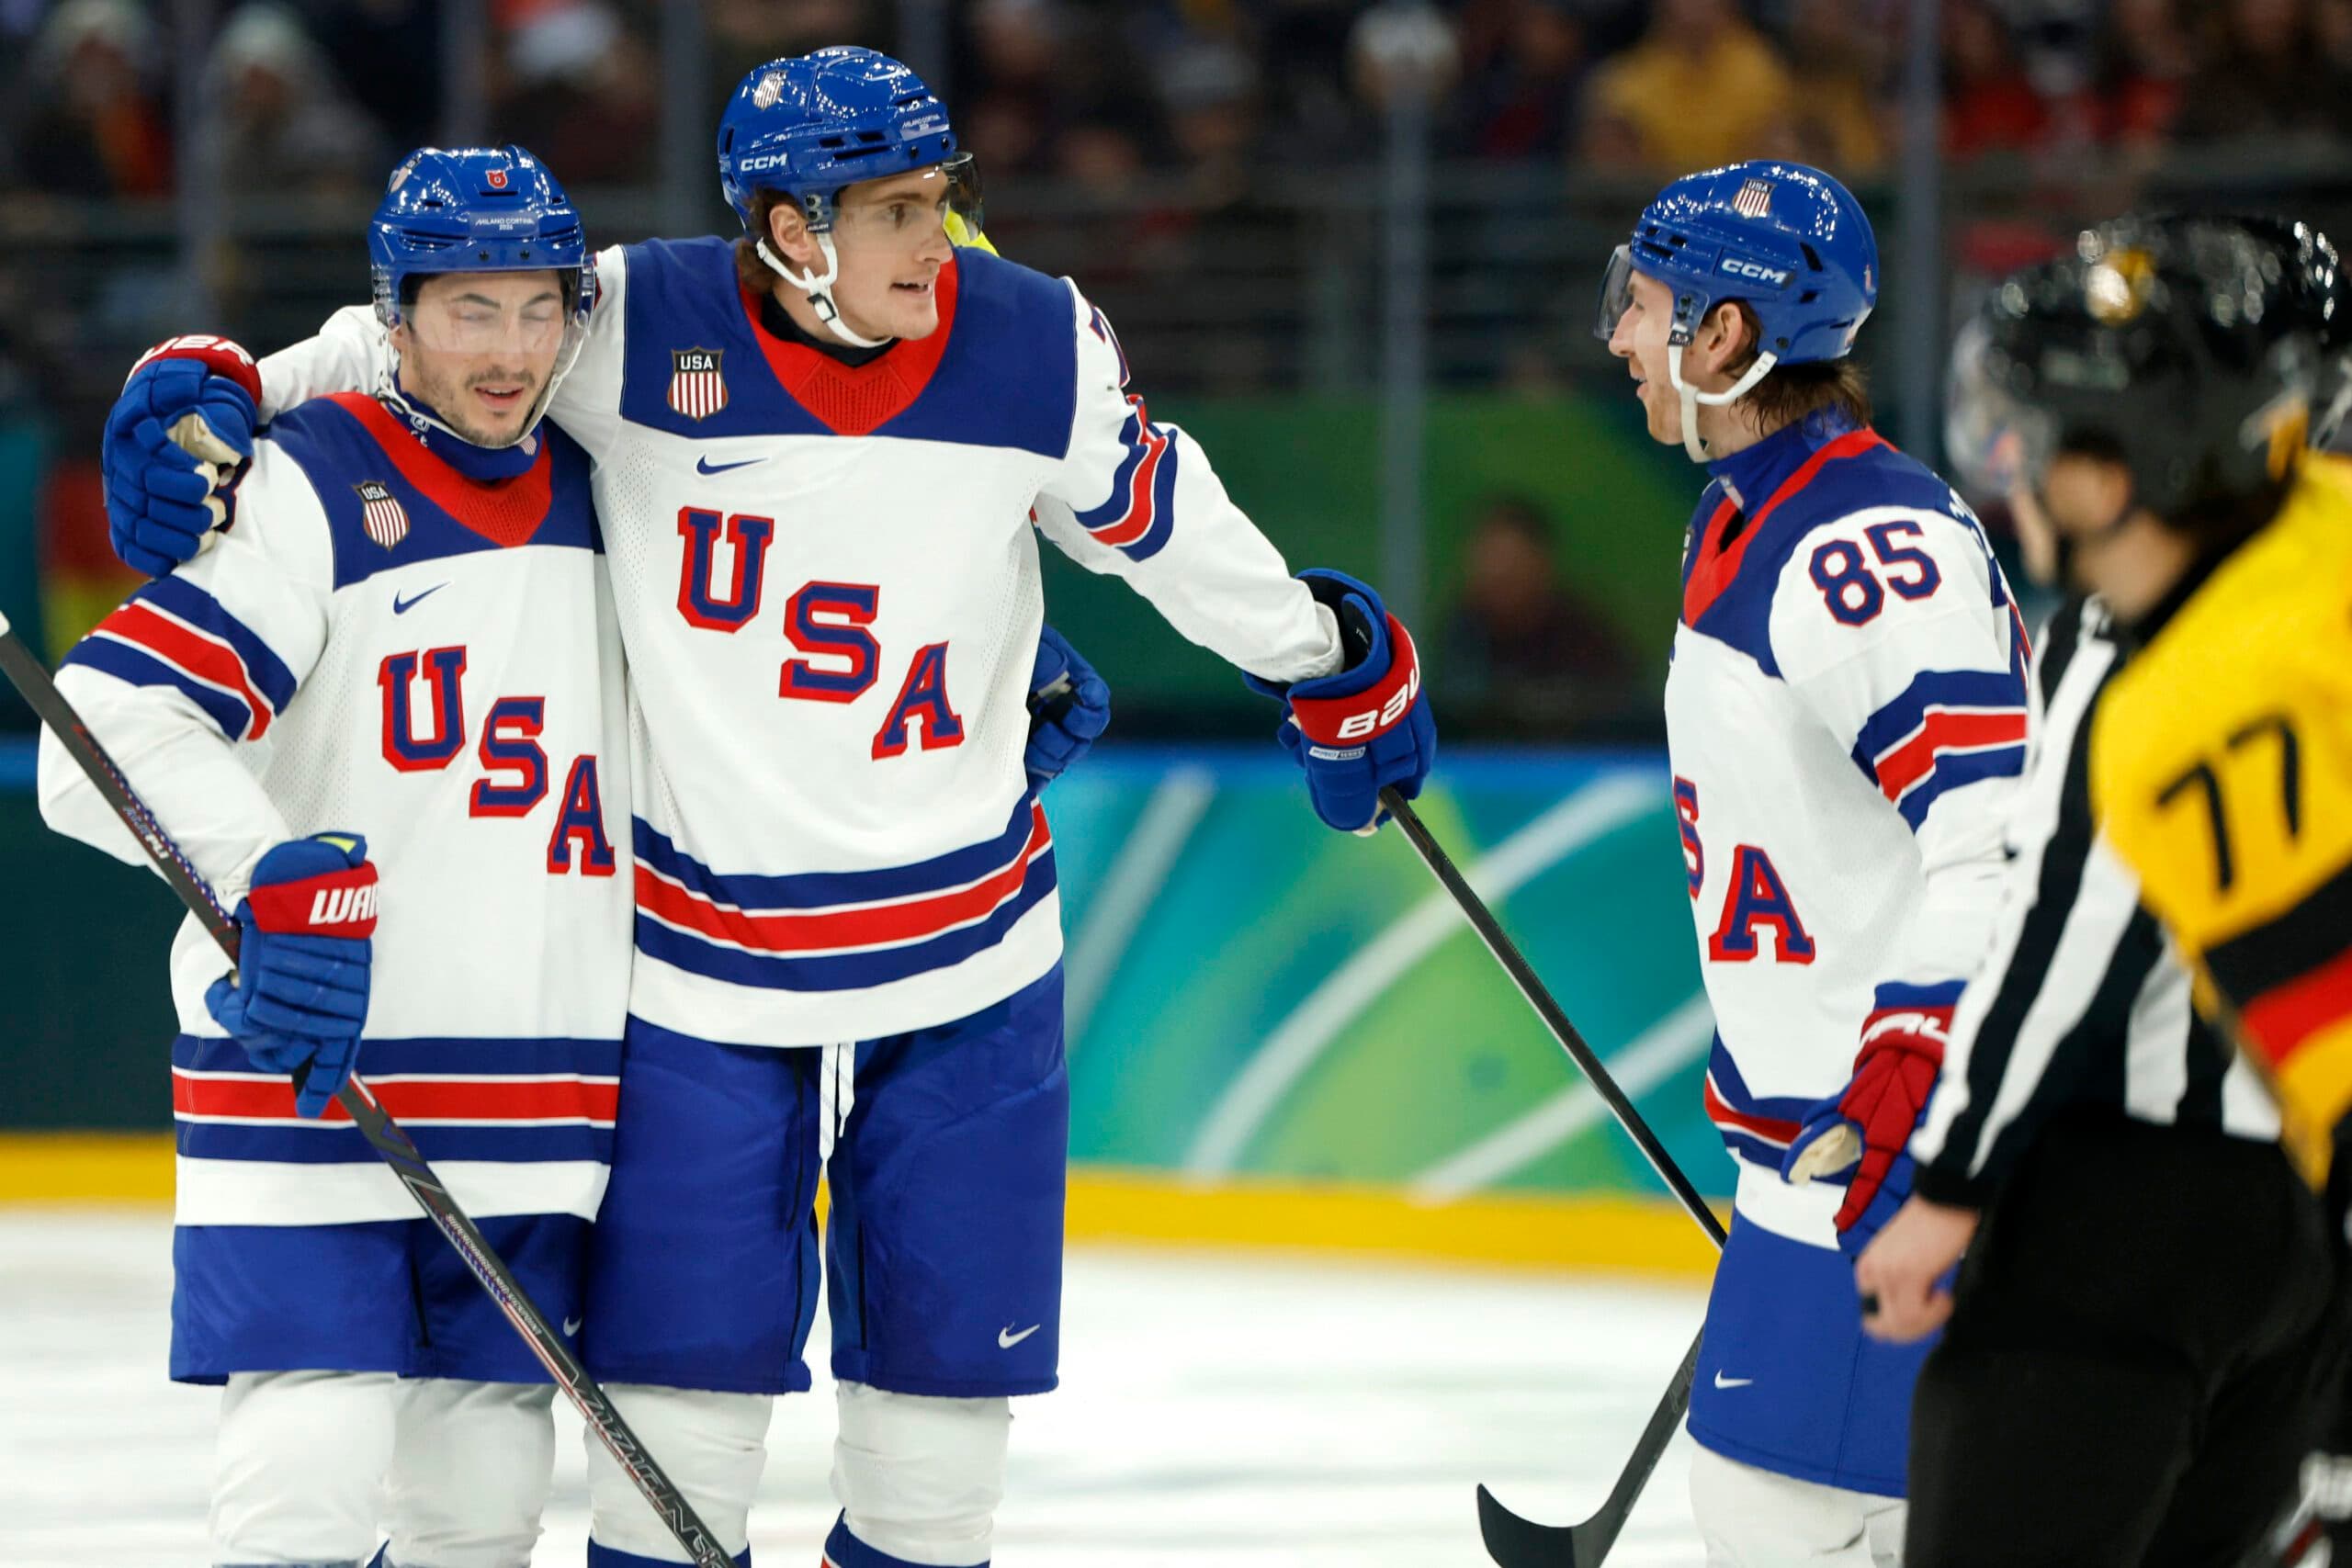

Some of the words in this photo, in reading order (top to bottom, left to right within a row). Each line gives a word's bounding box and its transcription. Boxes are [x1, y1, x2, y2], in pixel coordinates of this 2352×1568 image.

[741, 152, 788, 172] CCM
[1721, 257, 1787, 284] CCM
[680, 354, 713, 371] USA
[361, 484, 389, 501] USA
[1808, 520, 1942, 627] 85
[677, 506, 966, 761] USA
[378, 645, 616, 876] USA
[2154, 711, 2302, 891] 77
